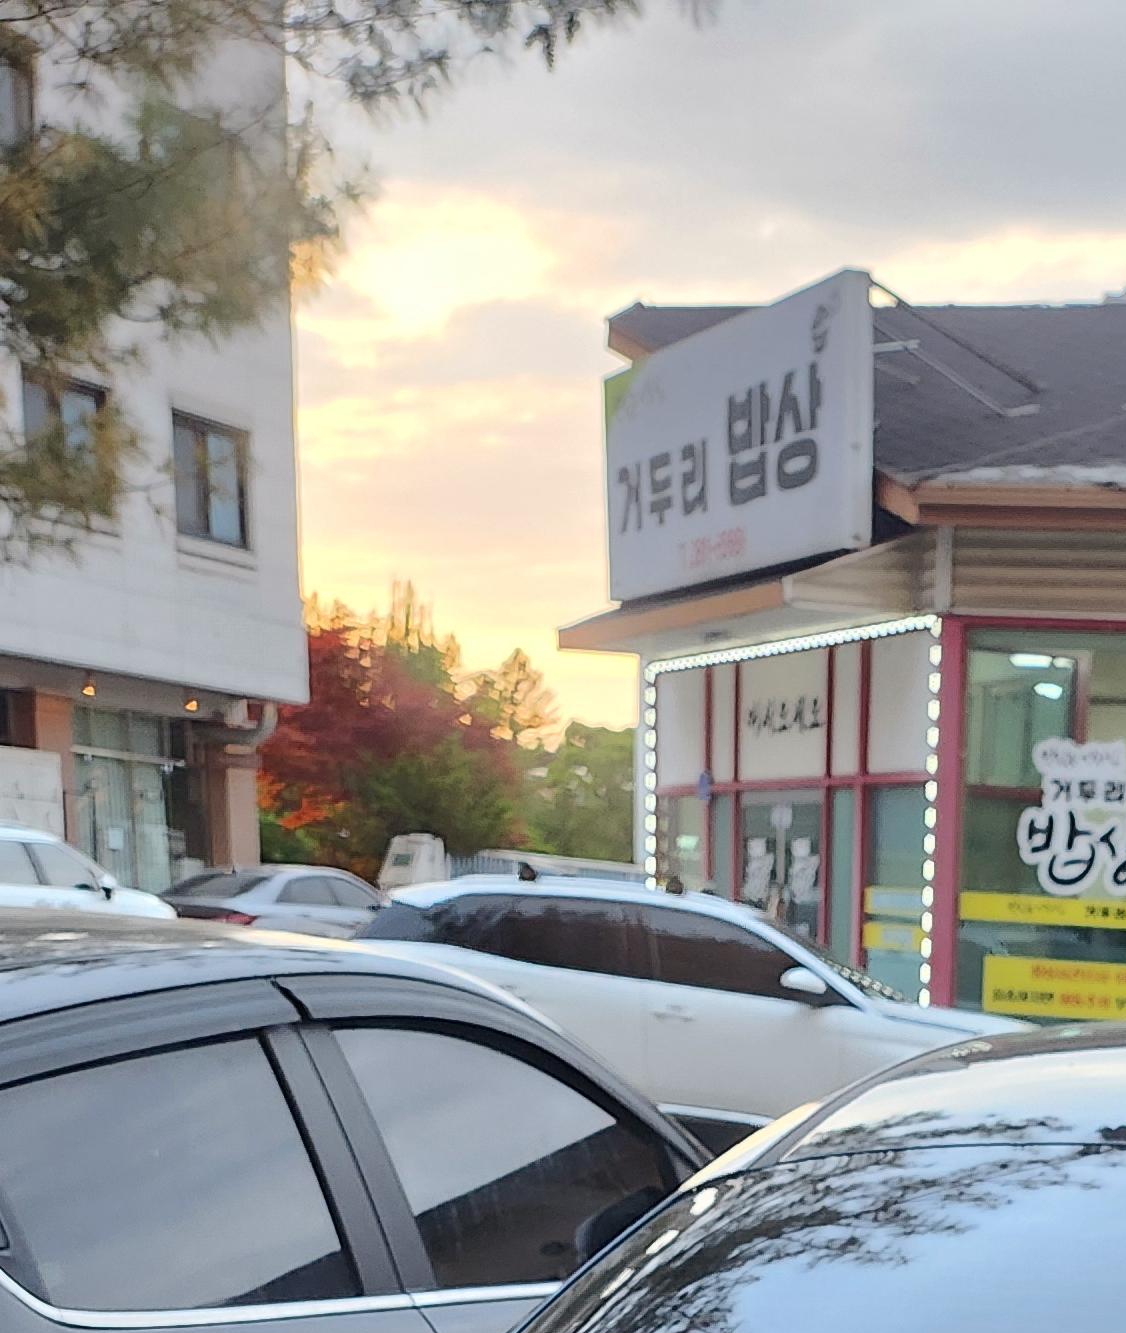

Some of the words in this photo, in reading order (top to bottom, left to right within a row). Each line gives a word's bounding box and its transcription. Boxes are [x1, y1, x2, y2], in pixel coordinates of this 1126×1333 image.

[617, 437, 707, 534] 거두리
[727, 362, 821, 506] 밥상
[1051, 779, 1126, 804] 거두리
